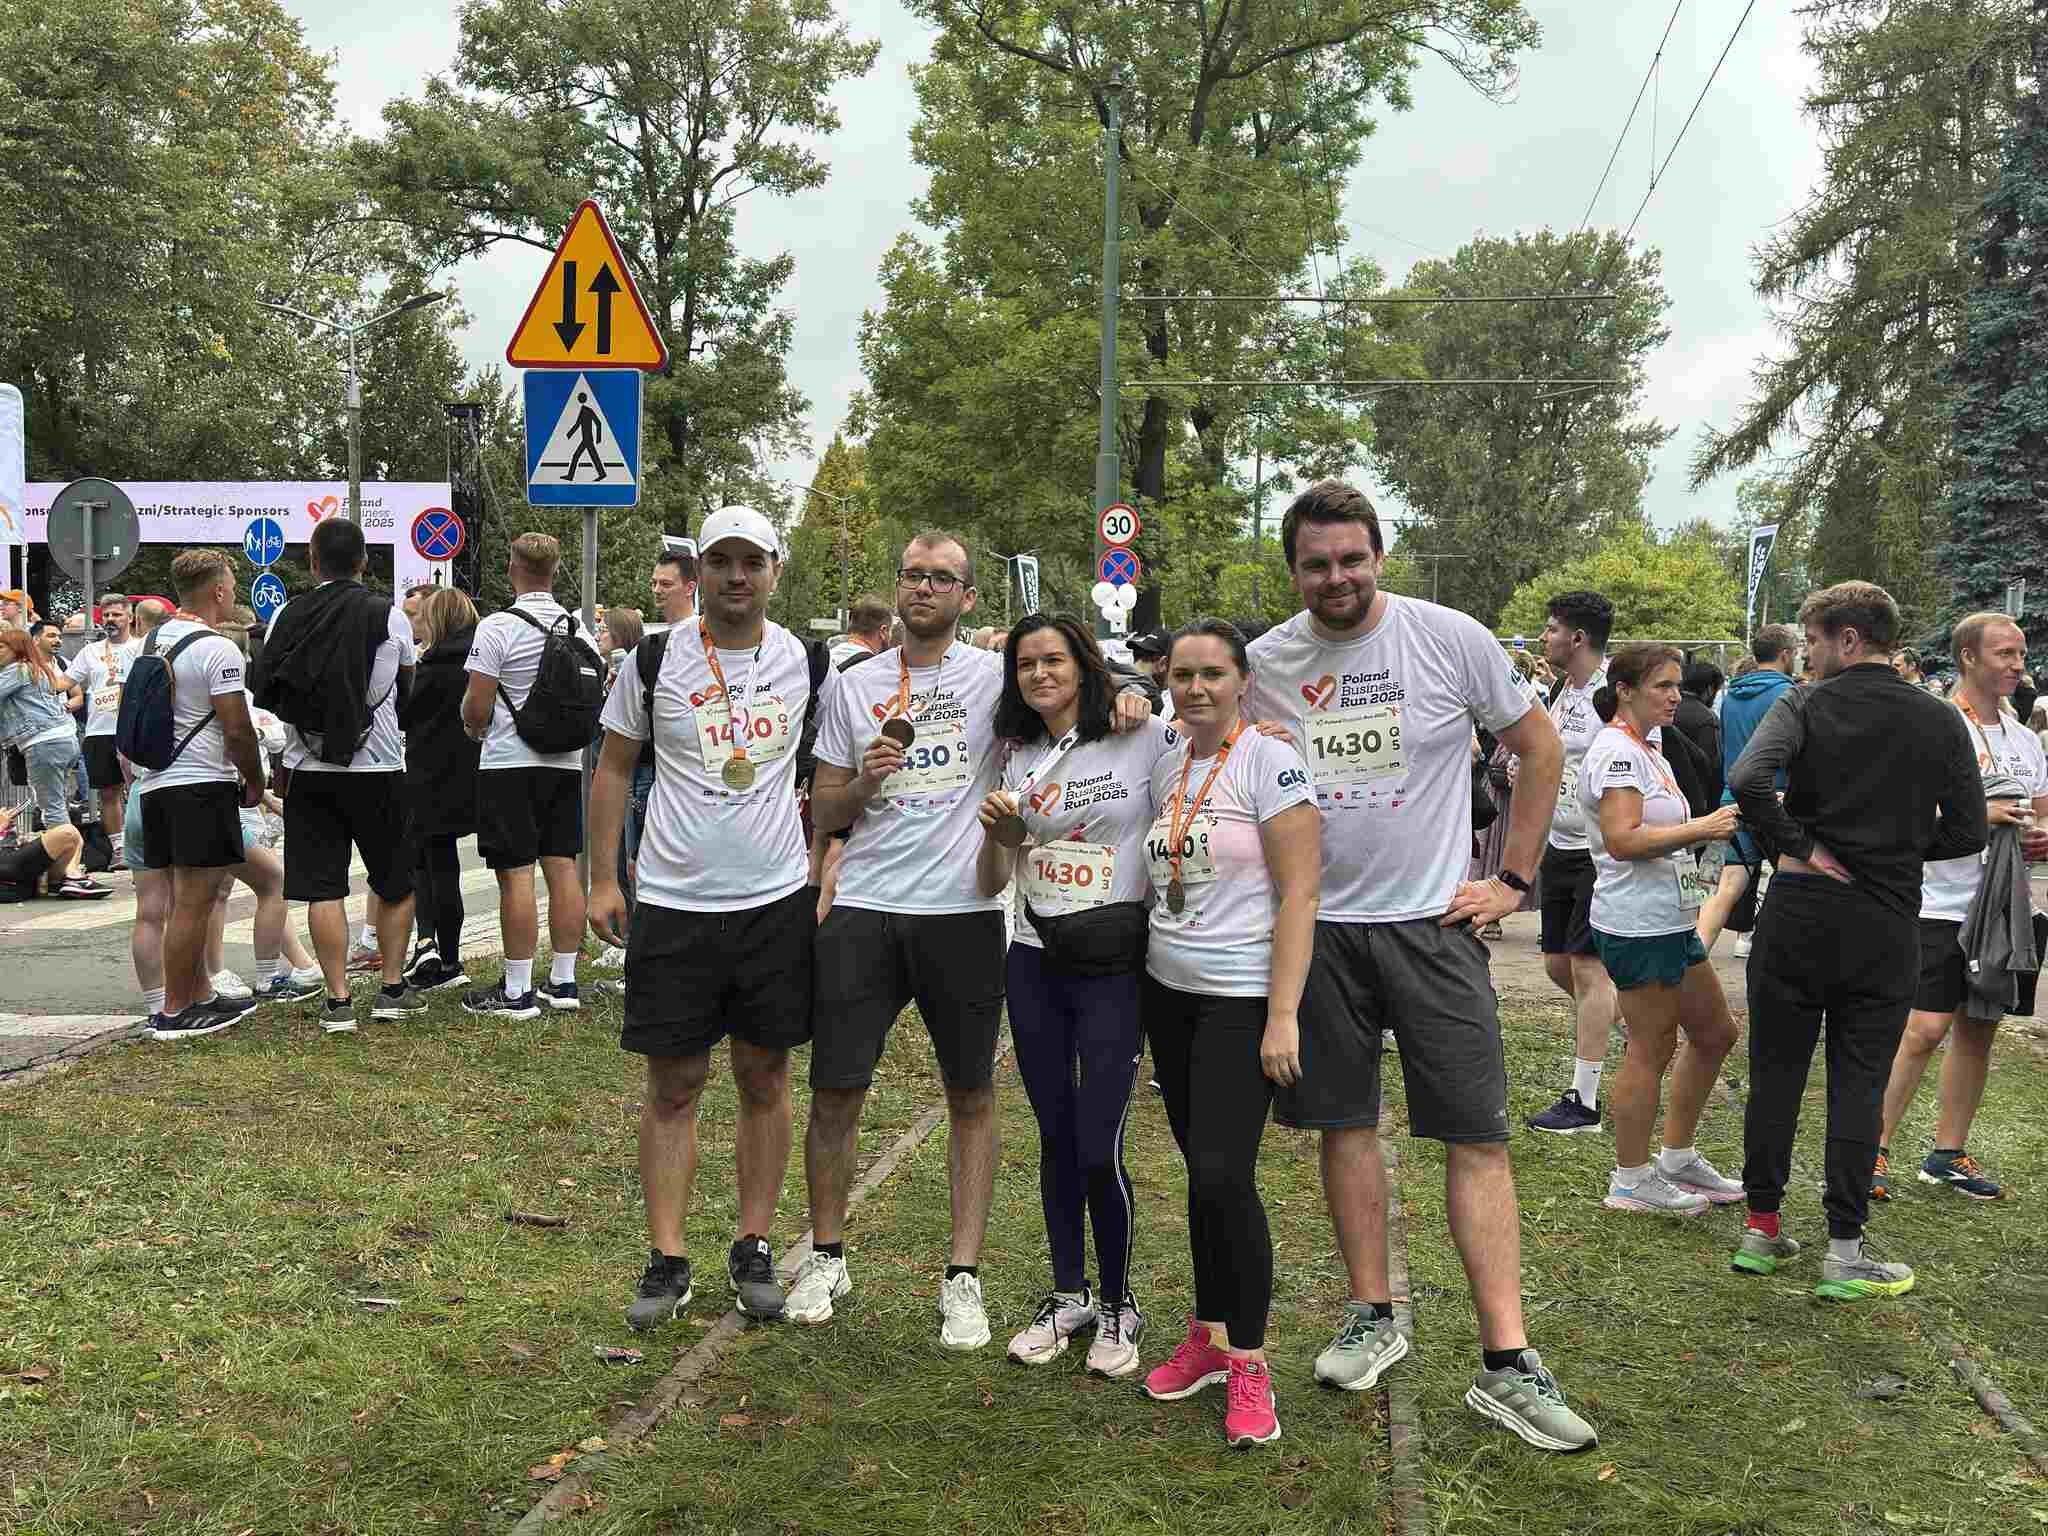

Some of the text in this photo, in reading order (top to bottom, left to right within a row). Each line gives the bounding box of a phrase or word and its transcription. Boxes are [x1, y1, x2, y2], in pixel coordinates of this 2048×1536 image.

[341, 497, 383, 507] Pand
[228, 505, 290, 518] Sponsors
[363, 517, 395, 528] 2025
[1106, 515, 1131, 536] 30
[1342, 668, 1390, 685] Poland
[1341, 681, 1399, 697] Business
[1340, 689, 1405, 708] Run 2025
[934, 708, 968, 720] 2025
[1389, 726, 1400, 737] Q
[957, 741, 967, 752] Q
[1312, 729, 1382, 760] 1430
[1391, 739, 1400, 751] 5
[903, 745, 951, 770] 430
[960, 754, 968, 764] 4
[1066, 771, 1113, 791] Poland
[1065, 780, 1122, 801] Business
[1063, 789, 1129, 811] Run 2025
[1200, 833, 1208, 844] Q
[1148, 836, 1195, 862] 140
[1035, 859, 1094, 888] 1430
[1101, 866, 1112, 878] Q
[1101, 880, 1110, 890] 3
